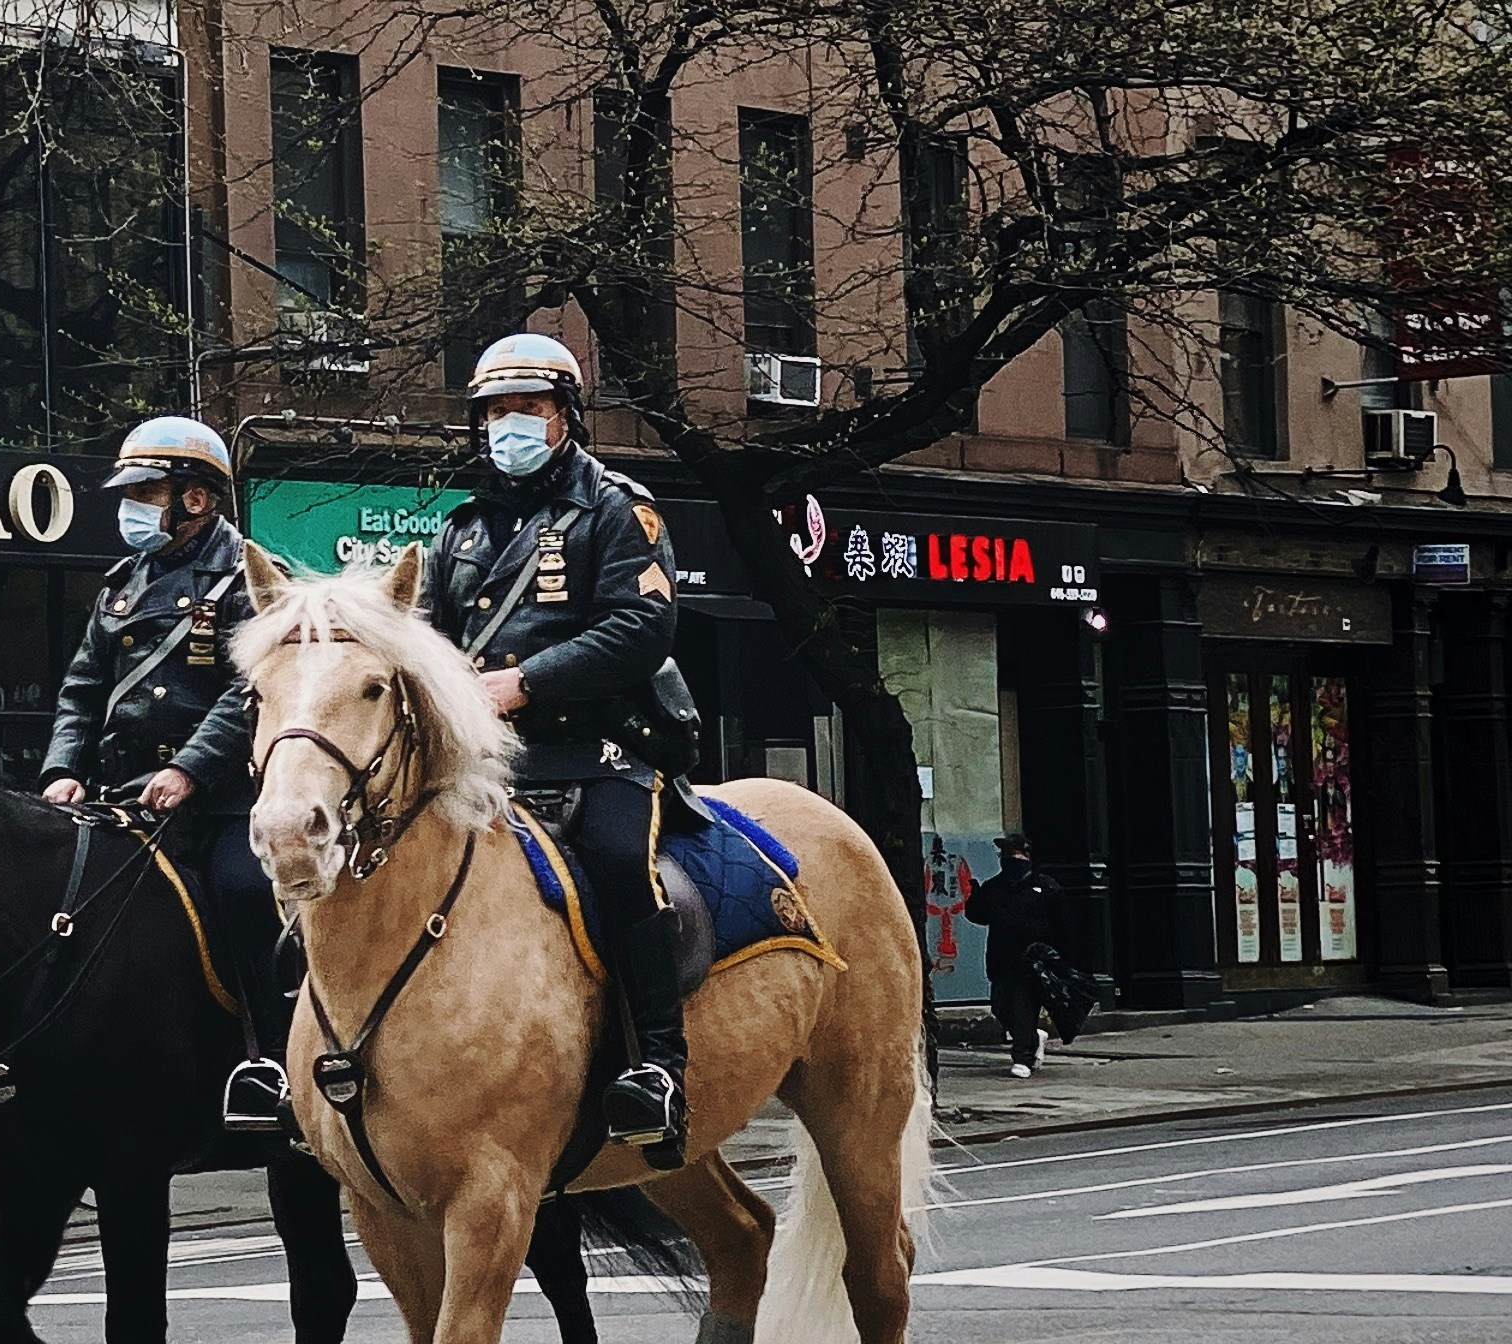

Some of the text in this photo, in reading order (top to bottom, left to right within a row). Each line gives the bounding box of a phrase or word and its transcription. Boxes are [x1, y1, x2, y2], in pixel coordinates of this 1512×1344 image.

[361, 507, 441, 534] Eat Good
[337, 536, 376, 564] City
[928, 534, 1035, 584] LESIA
[1439, 554, 1465, 564] RENT
